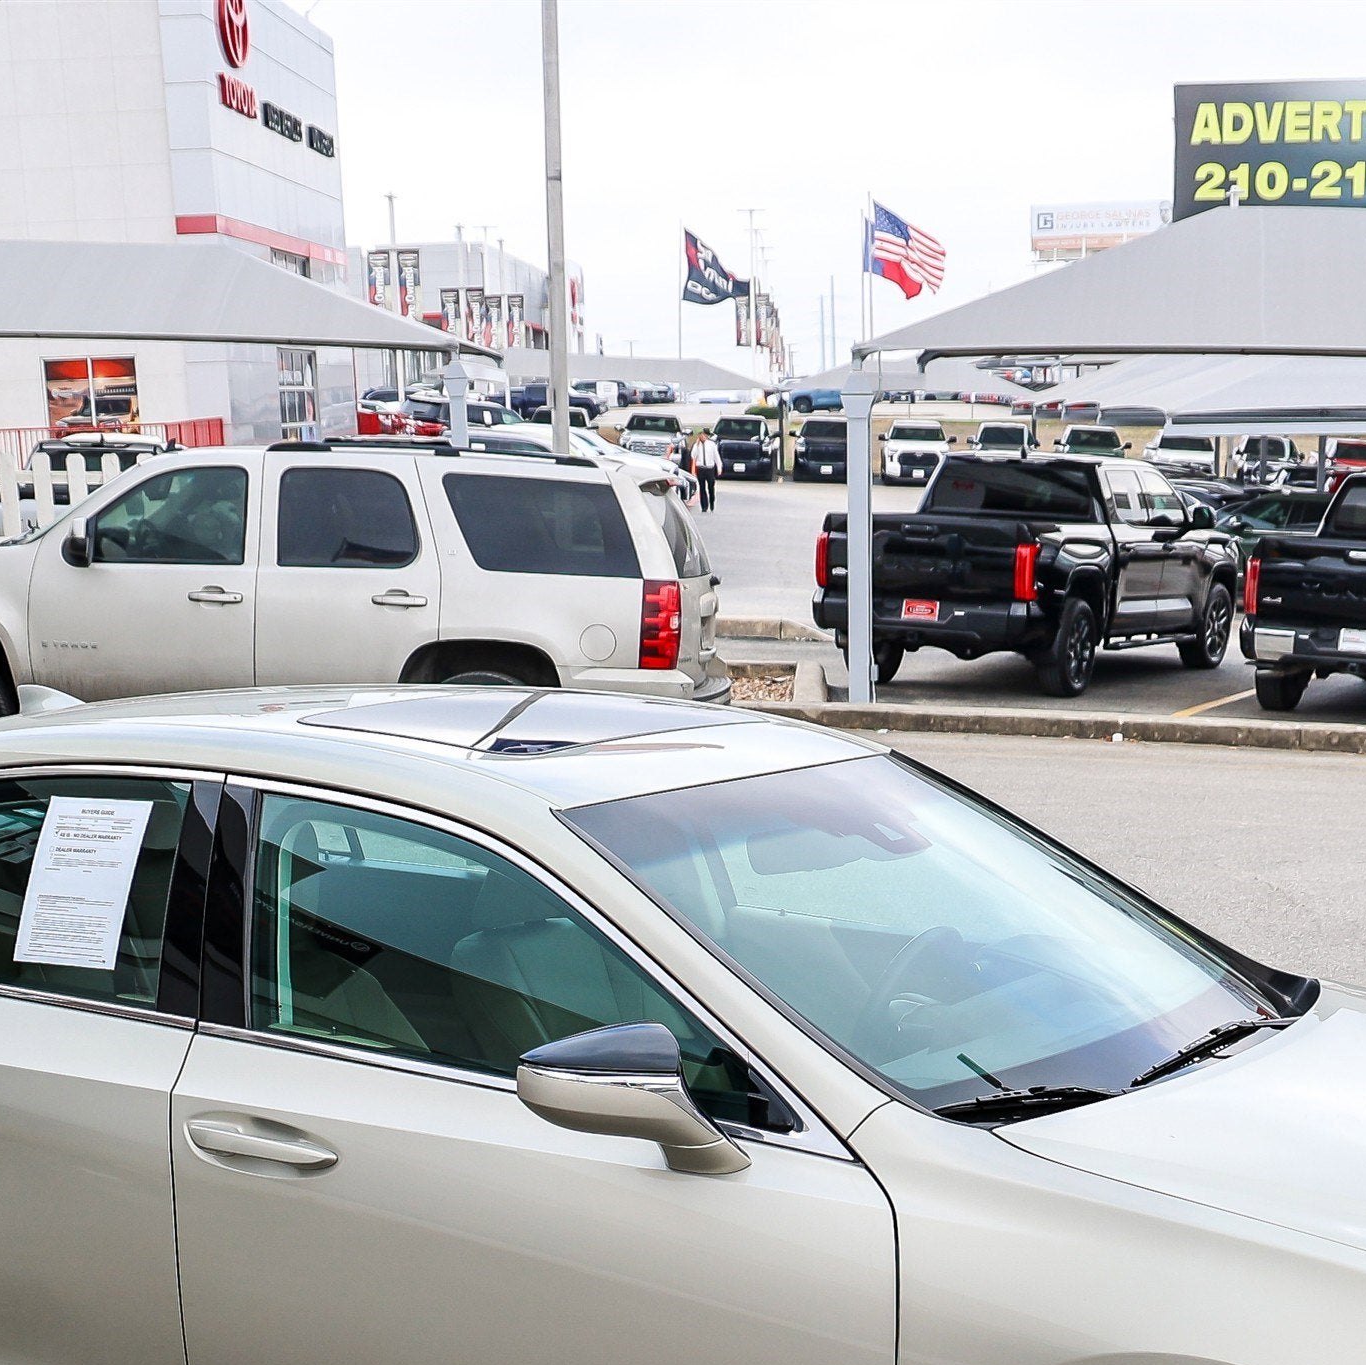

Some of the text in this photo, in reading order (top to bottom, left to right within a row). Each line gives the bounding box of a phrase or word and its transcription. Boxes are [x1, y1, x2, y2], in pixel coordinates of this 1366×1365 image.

[218, 72, 257, 119] TOYOTA
[1056, 208, 1152, 221] GEORGE SALINAS
[405, 266, 415, 302] Owned
